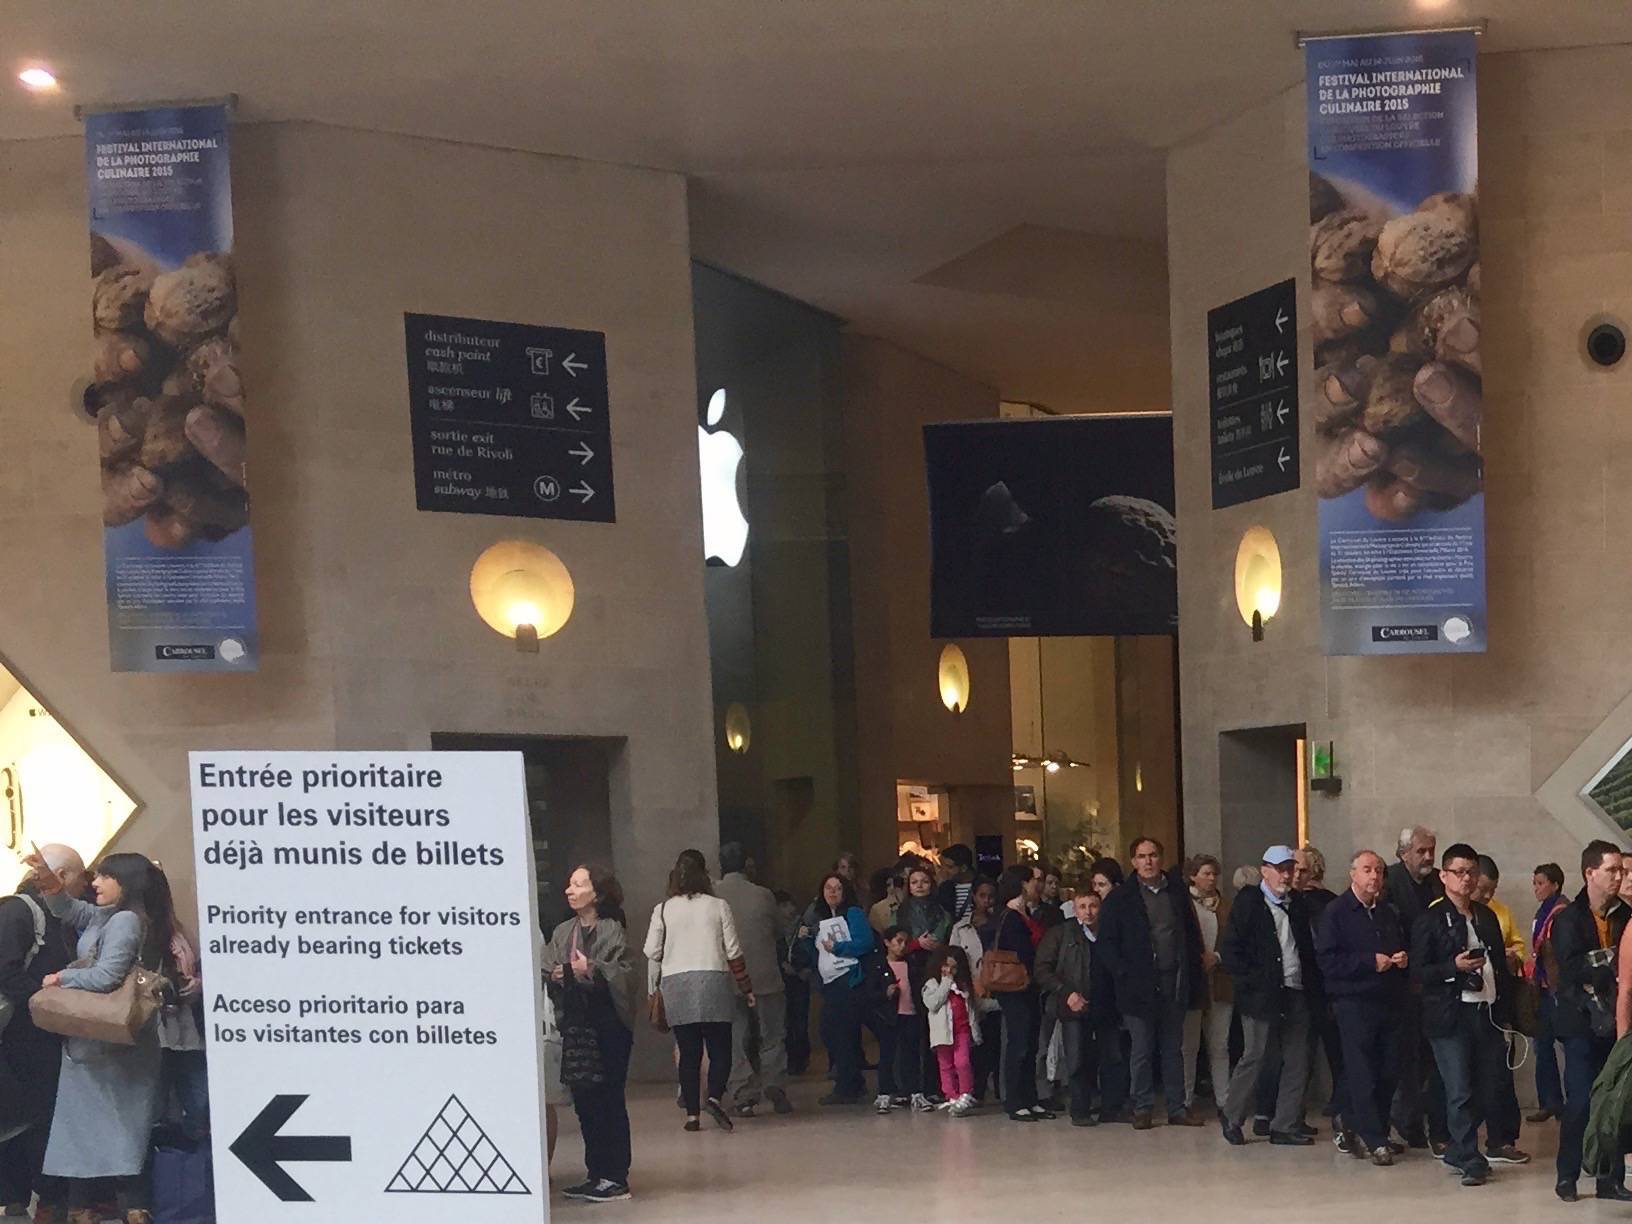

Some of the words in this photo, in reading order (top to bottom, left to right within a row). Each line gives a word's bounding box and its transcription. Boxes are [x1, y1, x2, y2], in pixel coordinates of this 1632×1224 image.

[1319, 73, 1371, 87] FESTIVAL
[1372, 67, 1464, 84] INTERNATIONAL
[1319, 89, 1333, 101] DE
[1335, 88, 1350, 100] LA
[1352, 83, 1441, 99] PHOTOGRAPHIE
[1320, 100, 1382, 115] CULINAIRE
[1384, 98, 1409, 111] 2015
[96, 144, 140, 154] FESTIVAL
[142, 138, 218, 153] INTERNATIONAL
[97, 156, 110, 167] DE
[111, 156, 122, 166] LA
[124, 152, 200, 165] PHOTOGRAPHIE
[97, 167, 150, 179] CULINAIRE
[152, 166, 173, 177] 2015
[425, 331, 501, 347] distributeur
[425, 347, 454, 360] cash
[457, 350, 491, 363] point
[428, 386, 492, 399] ascenseur
[495, 387, 513, 404] lift
[431, 430, 468, 443] sortie
[472, 432, 495, 444] exit
[431, 446, 453, 456] rue
[457, 445, 473, 457] de
[477, 446, 513, 460] Rivoli
[434, 483, 482, 498] subway
[539, 482, 555, 497] M
[1379, 627, 1429, 639] CARROUSEL
[200, 761, 292, 788] Entrée
[302, 762, 442, 794] prioritaire
[202, 808, 268, 833] pour
[279, 802, 317, 827] les
[327, 801, 450, 827] visiteurs
[203, 839, 263, 872] déjà
[274, 840, 363, 866] munis
[372, 840, 407, 866] de
[416, 840, 504, 867] billets
[207, 904, 288, 929] Priority
[295, 907, 393, 926] entrance
[398, 906, 431, 926] for
[437, 906, 521, 926] visitors
[209, 934, 290, 960] already
[298, 935, 382, 960] bearing
[389, 936, 463, 956] tickets
[213, 993, 291, 1015] Acceso
[299, 994, 408, 1018] prioritario
[416, 998, 465, 1018] para
[214, 1023, 246, 1044] los
[253, 1023, 362, 1045] visitantes
[369, 1027, 409, 1045] con
[416, 1025, 498, 1045] billetes
